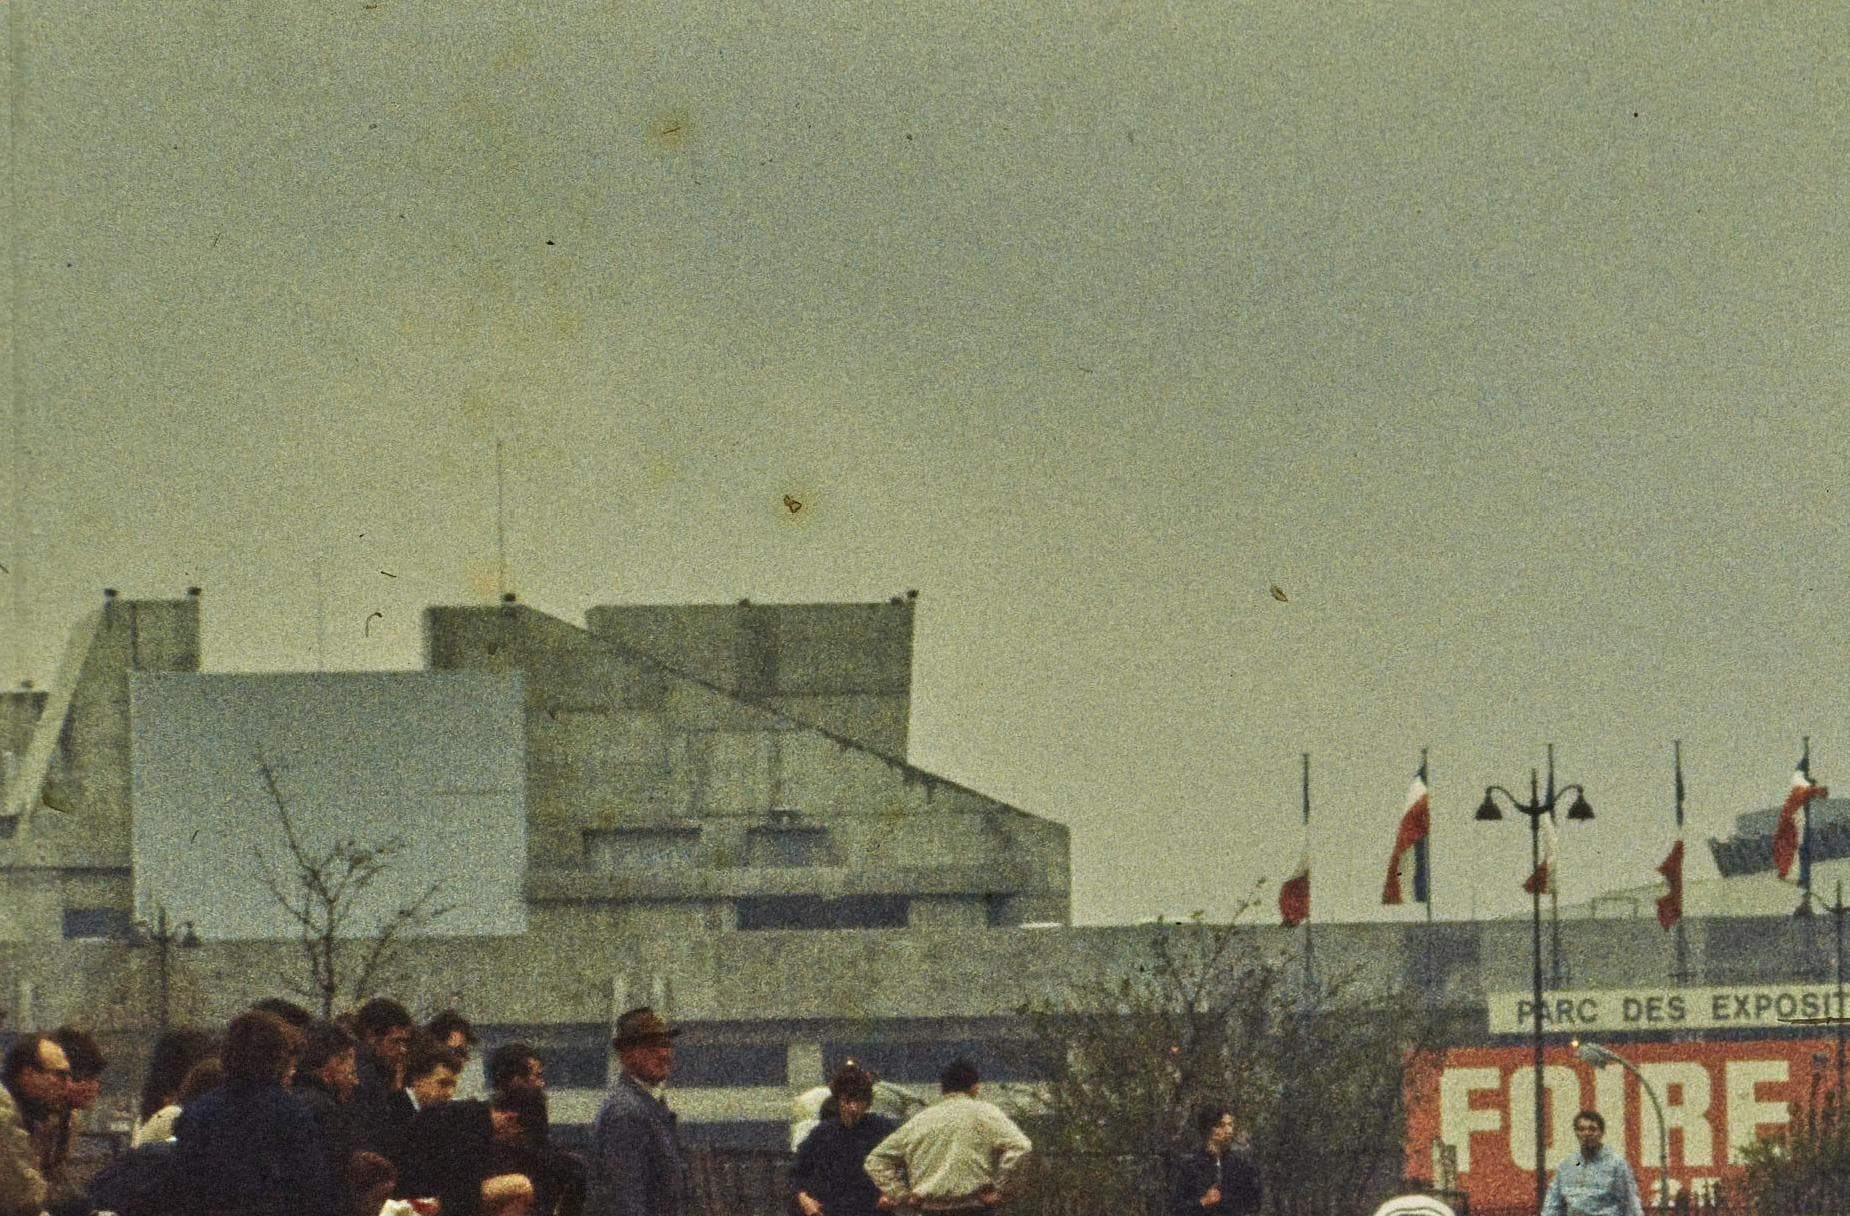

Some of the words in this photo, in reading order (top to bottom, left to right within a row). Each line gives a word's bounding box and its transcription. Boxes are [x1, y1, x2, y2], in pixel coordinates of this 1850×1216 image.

[1517, 998, 1599, 1024] PARC
[1622, 995, 1686, 1022] DES
[1440, 1060, 1792, 1173] FOIRE
